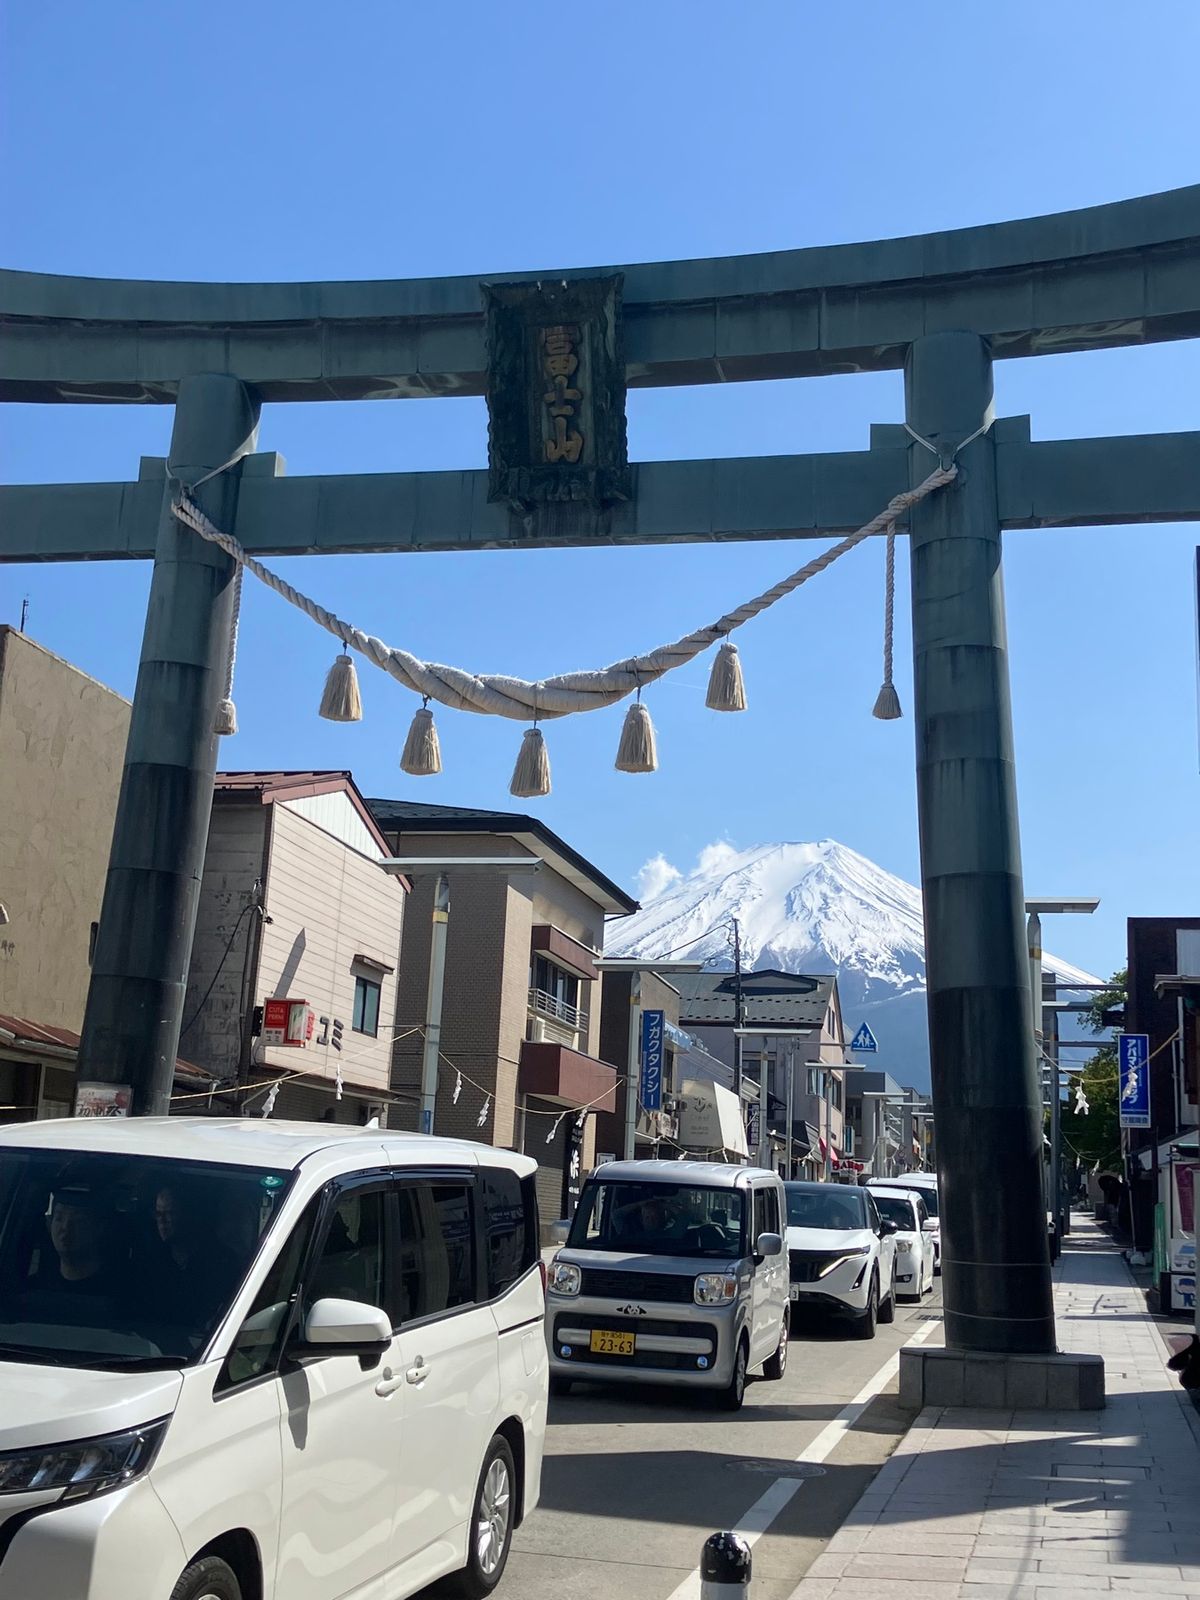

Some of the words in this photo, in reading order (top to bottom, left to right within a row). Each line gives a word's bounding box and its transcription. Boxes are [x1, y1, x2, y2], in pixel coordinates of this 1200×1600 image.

[317, 1016, 345, 1052] ユミ
[647, 1014, 660, 1106] フガクタクシー
[600, 1339, 632, 1353] 23-63
